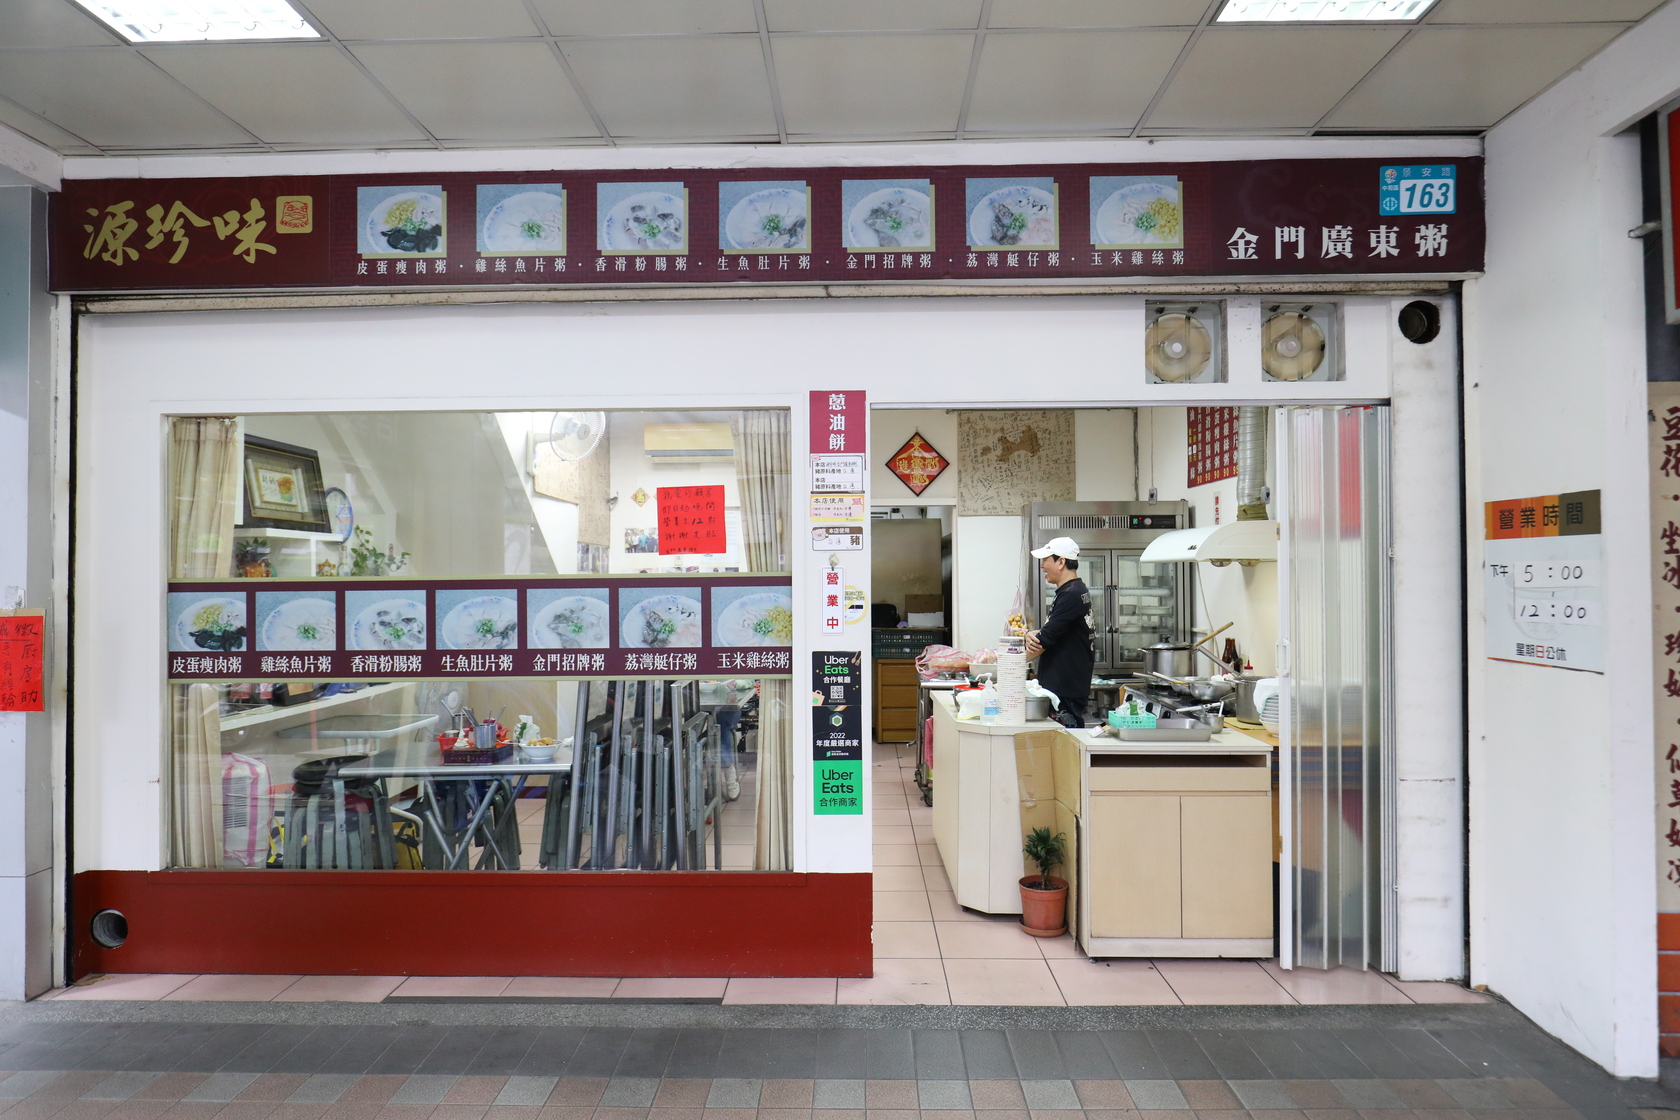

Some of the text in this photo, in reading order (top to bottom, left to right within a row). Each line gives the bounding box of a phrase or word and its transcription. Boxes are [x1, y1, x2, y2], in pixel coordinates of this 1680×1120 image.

[1402, 167, 1451, 177] 景安路
[1405, 183, 1450, 208] 163
[83, 199, 277, 266] 源珍味
[1226, 223, 1448, 261] 金門廣東粥
[357, 250, 1184, 275] 皮蛋瘦肉粥 雞絲魚片粥 香滑粉腸粥 生魚肚片粥 金門招牌粥 荔灣艇仔粥 玉米雞絲粥
[1214, 470, 1220, 479] 90
[1223, 467, 1229, 477] 90
[1499, 502, 1583, 530] 營業時間
[1490, 564, 1583, 582] 下午 5:00
[827, 573, 839, 629] 營業中
[1520, 604, 1587, 618] 12:00
[717, 652, 789, 669] 玉米雞絲粥
[824, 655, 849, 664] Uber
[1516, 643, 1566, 661] 星期日公休
[172, 656, 242, 674] 皮蛋瘦肉粥
[260, 656, 332, 673] 雞絲魚片粥
[350, 655, 422, 673] 香滑粉腸粥
[441, 655, 513, 672] 生魚肚片粥
[532, 654, 605, 672] 金門招牌粥
[624, 653, 697, 671] 荔灣艇仔粥
[824, 665, 849, 674] Eats
[822, 770, 854, 780] Uber
[822, 782, 854, 794] Eats
[819, 798, 857, 807] 合作商家
